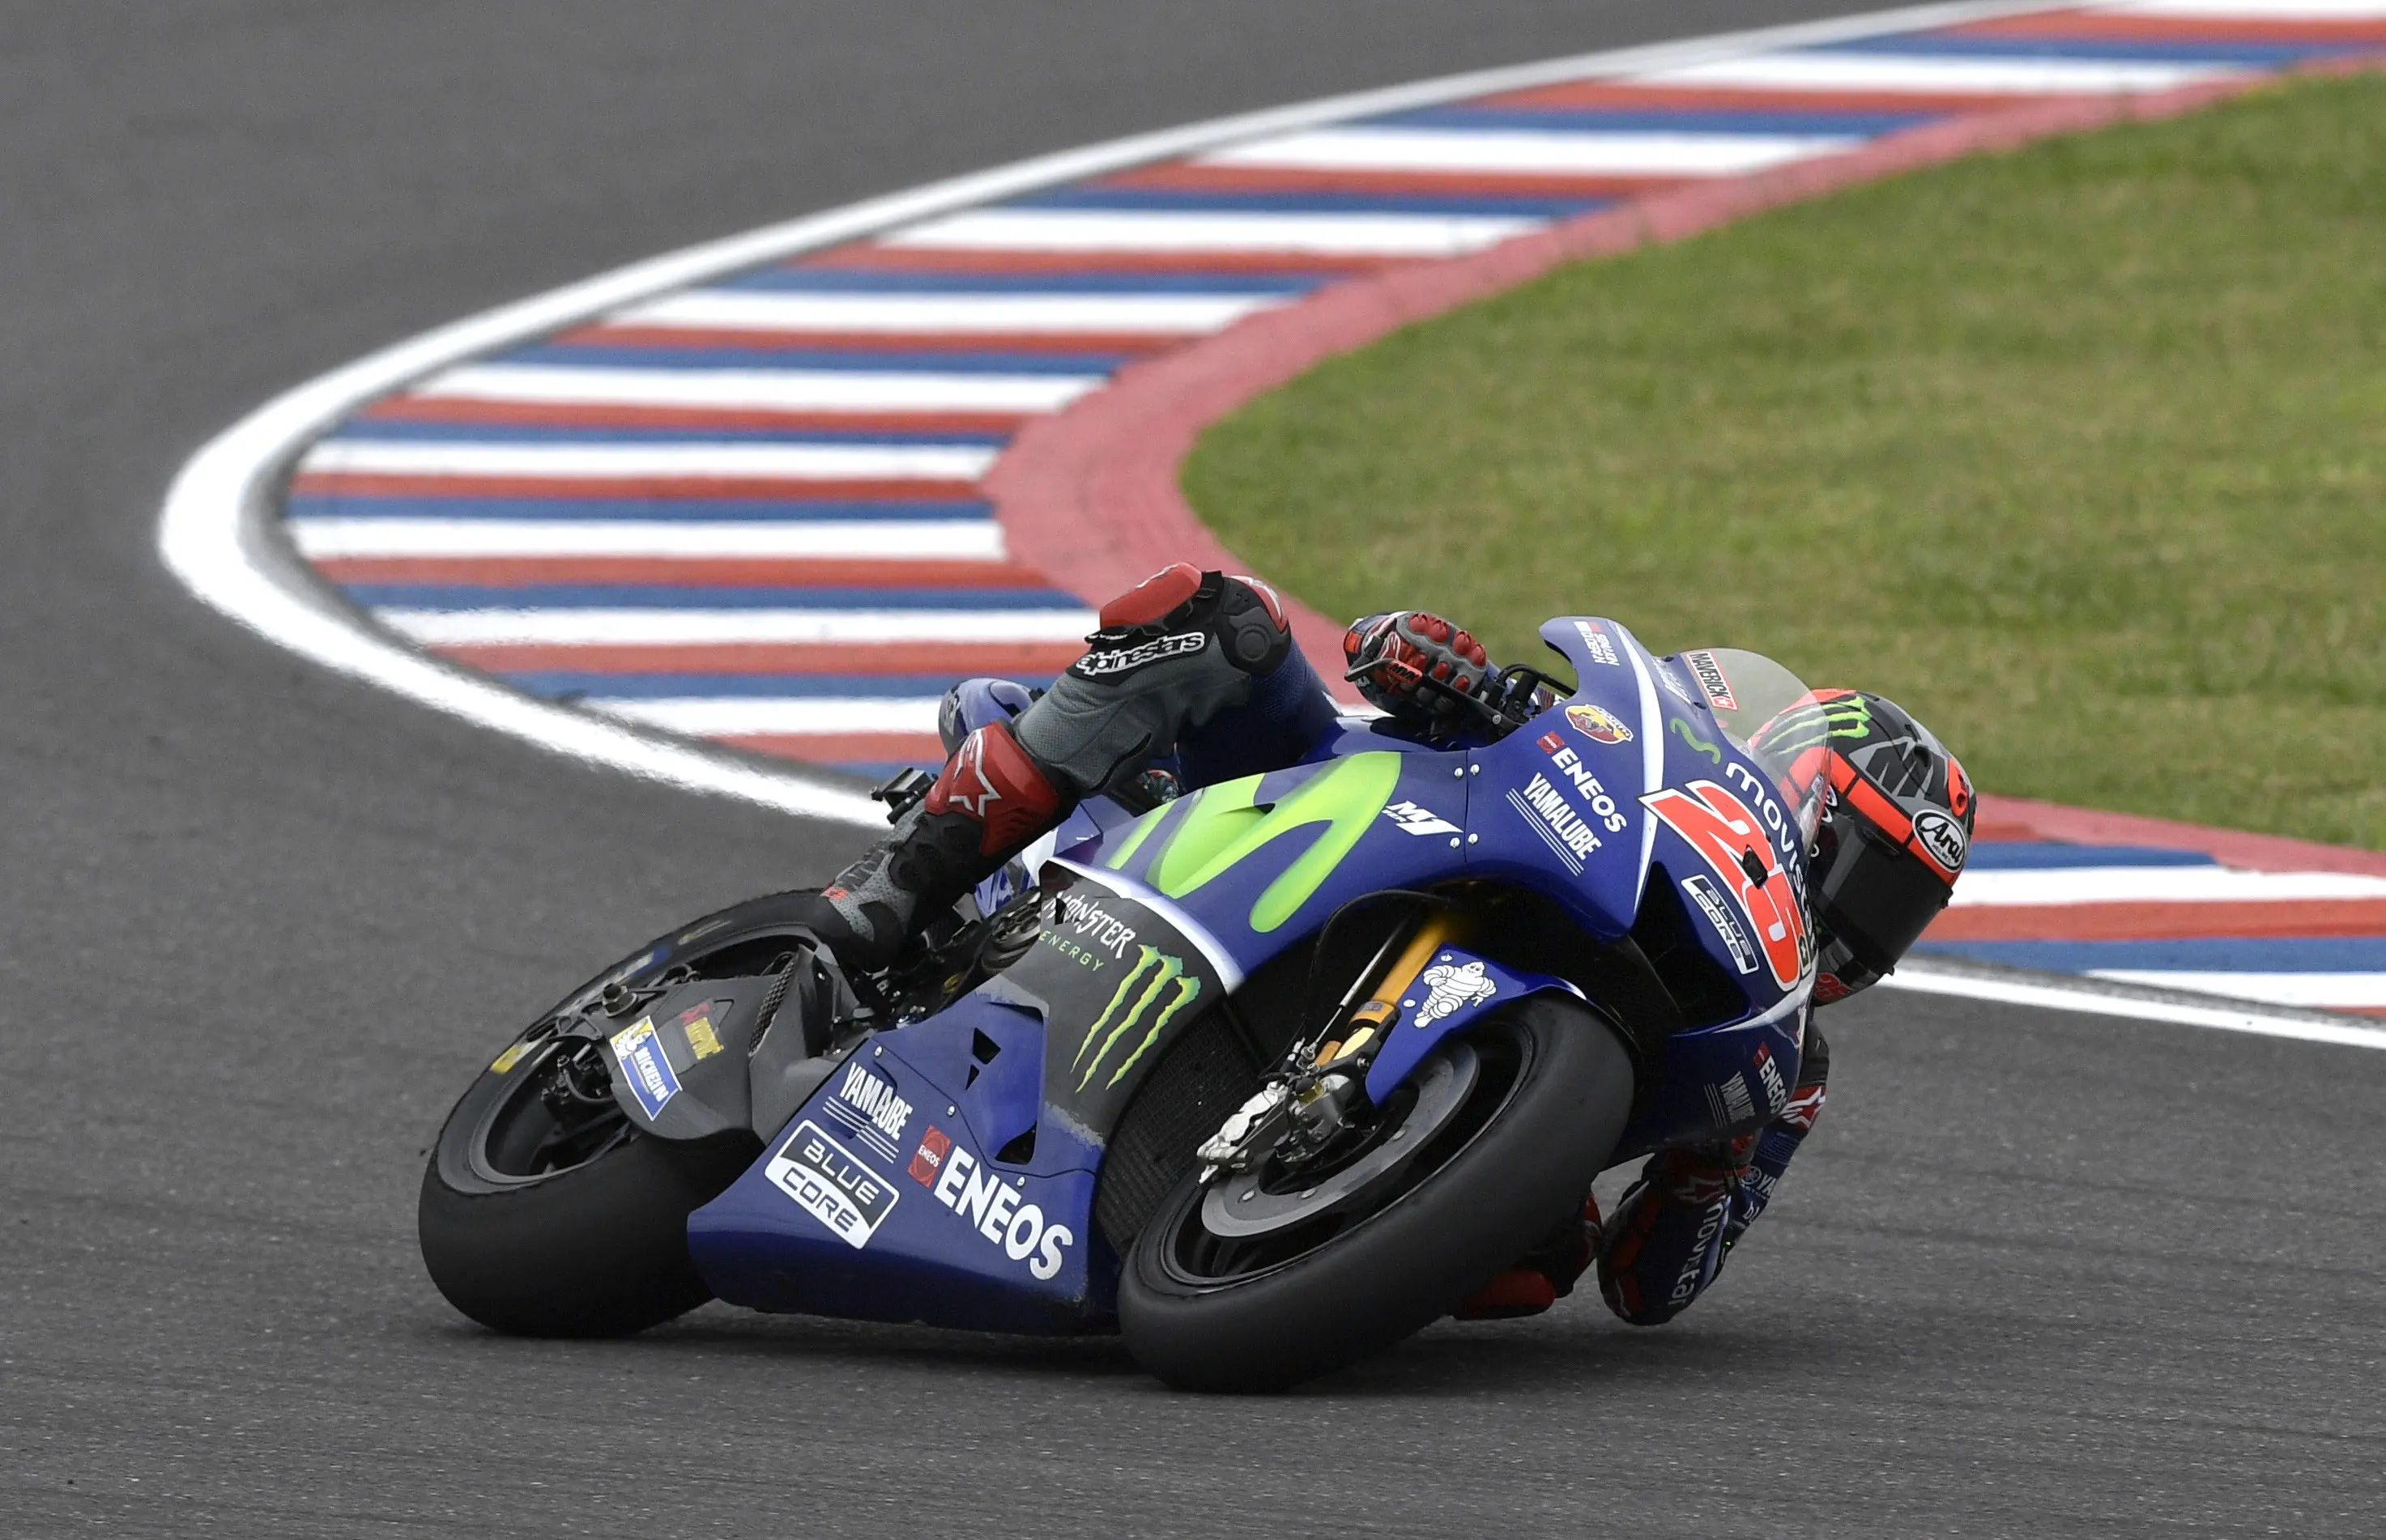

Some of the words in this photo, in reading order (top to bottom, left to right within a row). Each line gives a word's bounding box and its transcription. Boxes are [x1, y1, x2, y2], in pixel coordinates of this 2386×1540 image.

[1076, 632, 1205, 676] alpinestars
[1689, 653, 1731, 699] MAVERICK
[1523, 772, 1603, 861] YAMALUBE
[1552, 747, 1627, 832] ENEOS
[1918, 822, 1964, 863] Arai
[1638, 780, 1803, 991] 25
[1038, 930, 1105, 972] ENERGY
[1043, 891, 1136, 959] MONSTER
[1705, 889, 1750, 957] BLUE
[634, 1047, 669, 1103] MICHELIN
[1759, 1055, 1787, 1114] ENEOS
[803, 1138, 880, 1205] BLUE
[918, 1144, 940, 1168] ENEOS
[782, 1166, 859, 1233] CORE
[934, 1146, 1073, 1280] ENEOS
